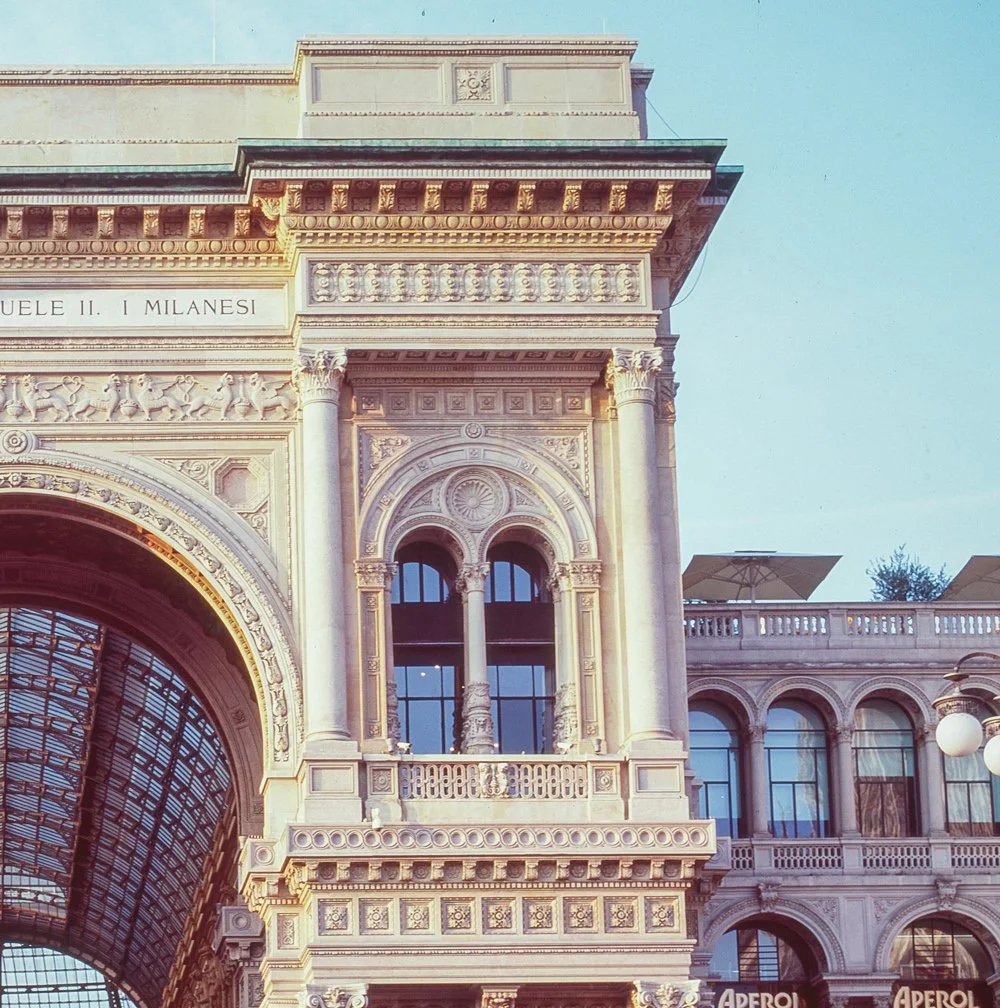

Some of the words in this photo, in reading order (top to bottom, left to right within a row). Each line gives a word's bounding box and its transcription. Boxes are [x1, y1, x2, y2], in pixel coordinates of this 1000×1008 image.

[79, 300, 100, 316] II.
[123, 299, 128, 316] I
[144, 299, 256, 316] MILANESI
